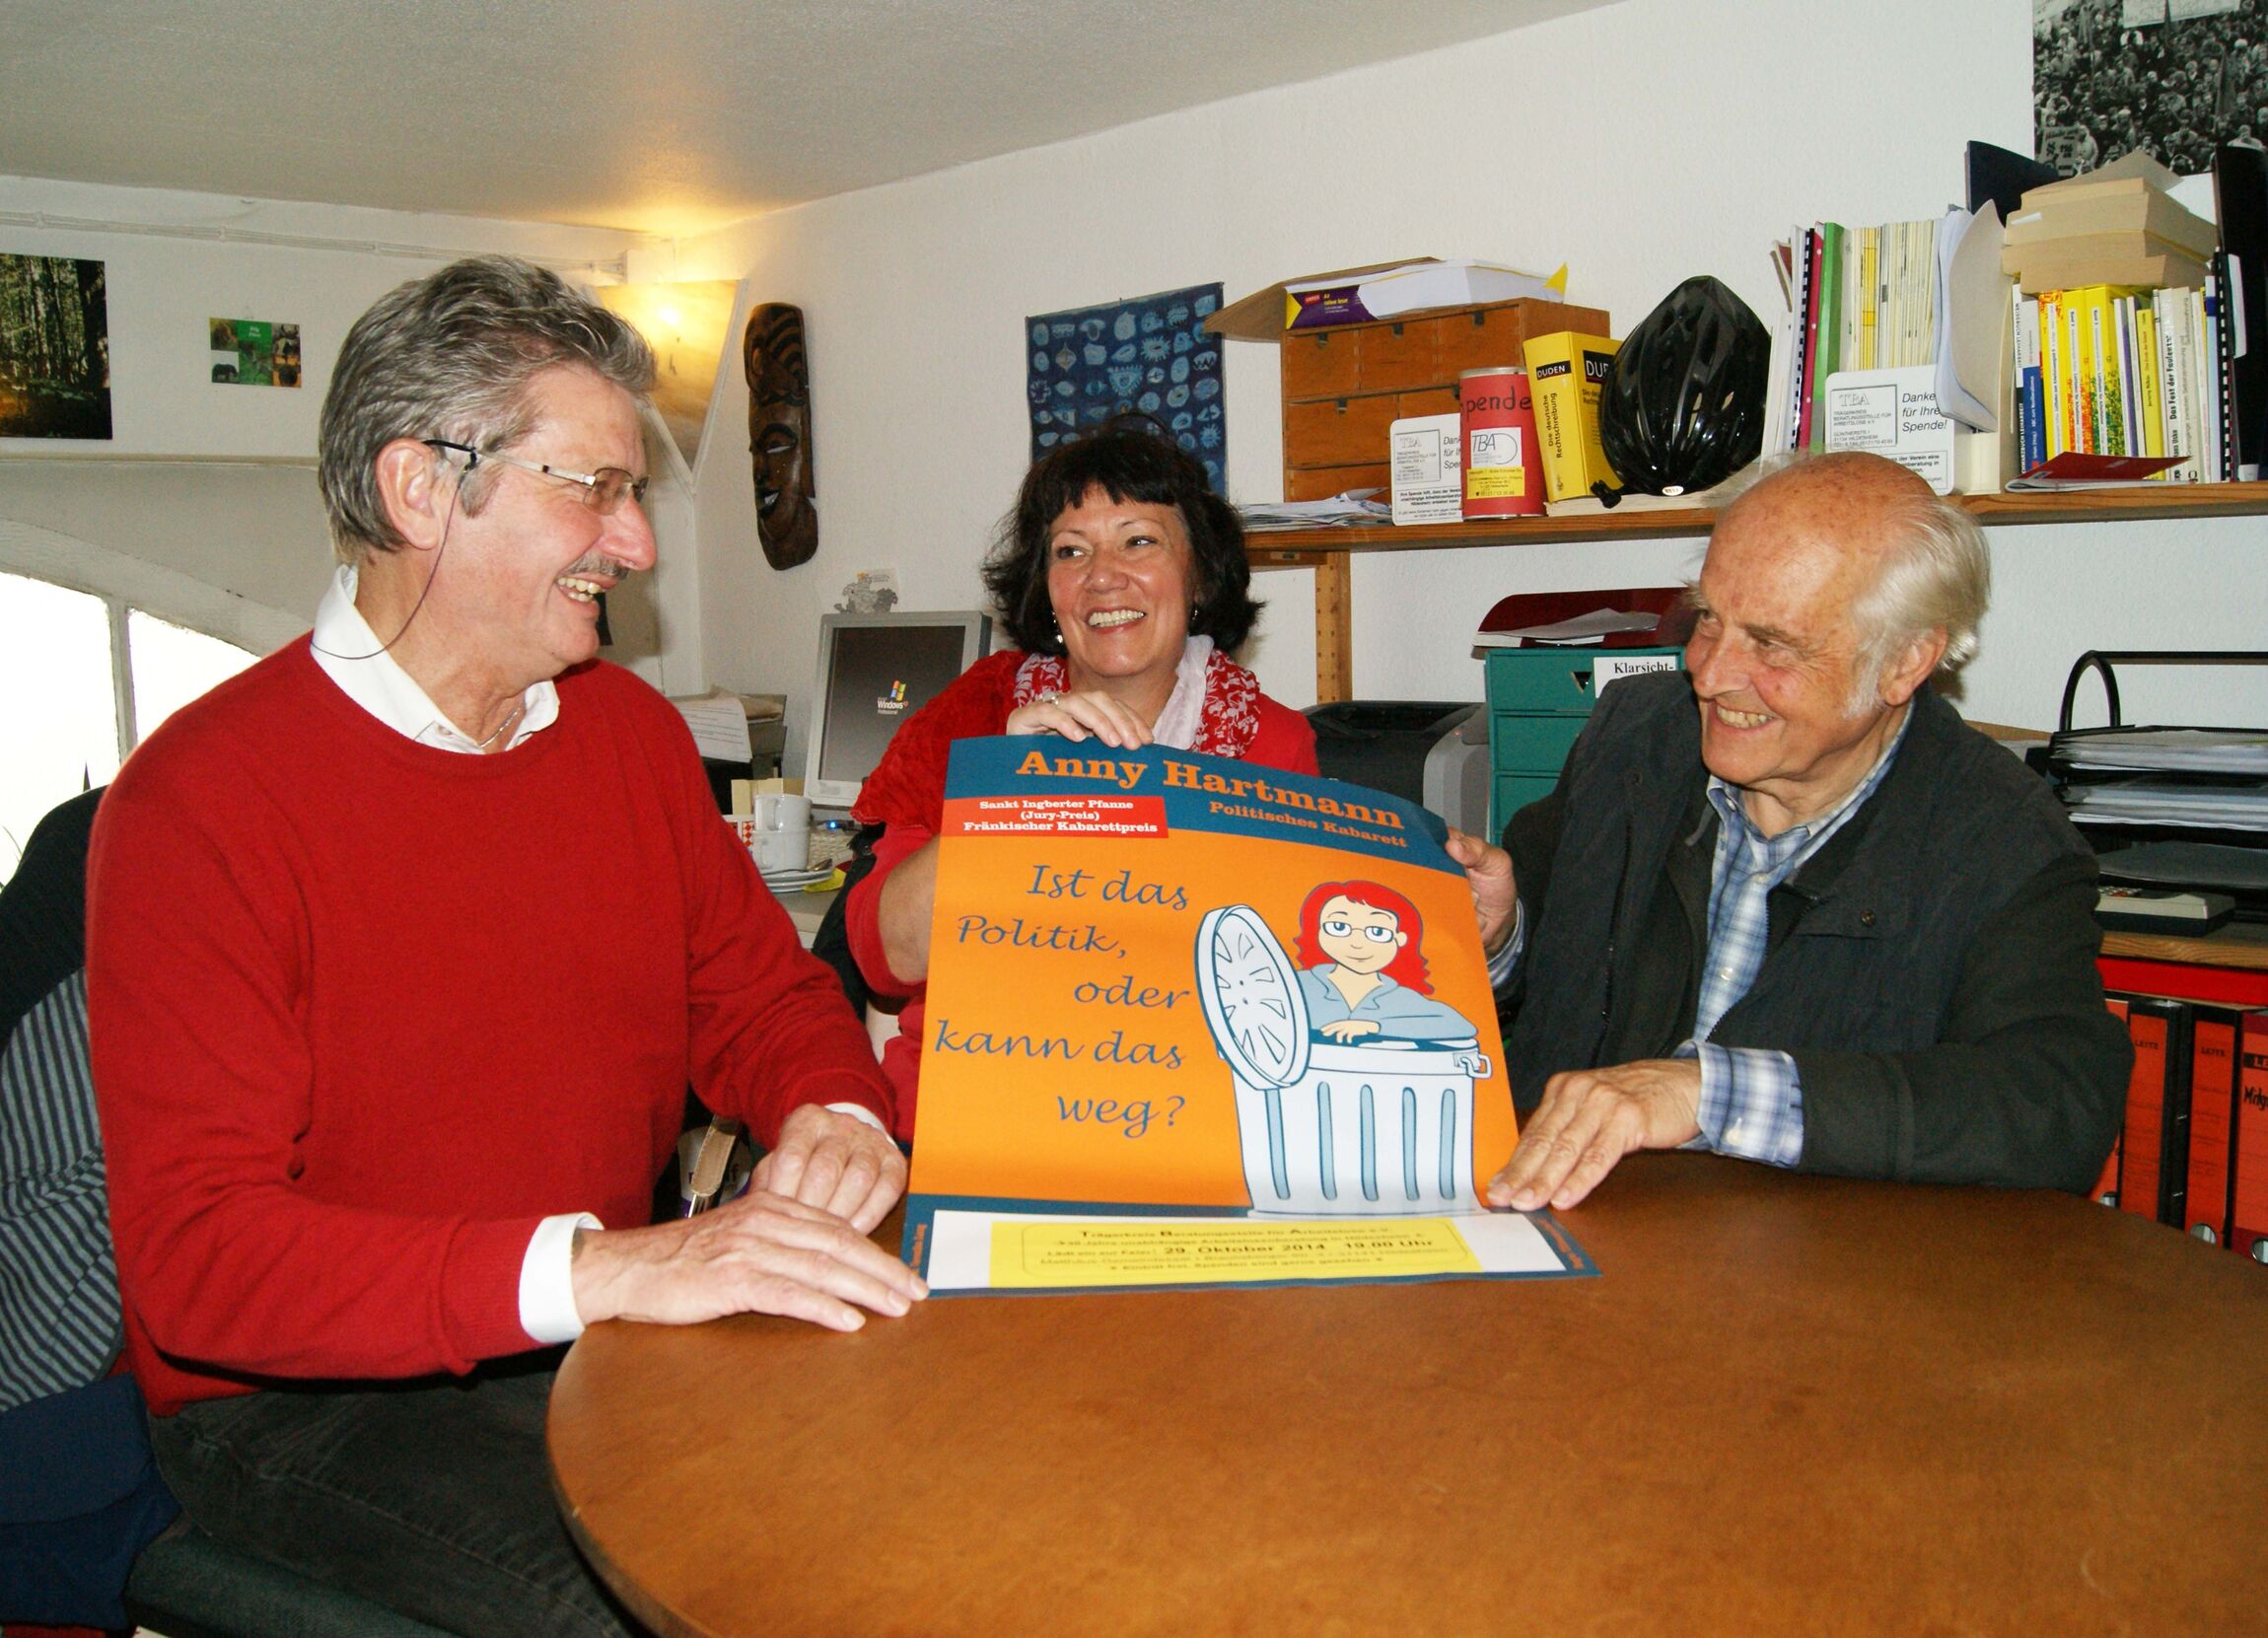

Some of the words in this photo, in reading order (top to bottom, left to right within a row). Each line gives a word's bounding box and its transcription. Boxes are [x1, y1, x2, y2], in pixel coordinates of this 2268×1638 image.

[1536, 364, 1566, 379] DUDEN
[2166, 373, 2175, 387] der
[1460, 386, 1531, 422] pende
[1902, 392, 1937, 403] Danke
[1541, 393, 1553, 430] deutsche
[1902, 407, 1919, 417] für
[1920, 406, 1941, 415] Ihre
[1550, 392, 1563, 459] Rechtschreibung
[1902, 419, 1948, 434] Spende!
[1471, 432, 1496, 453] TBA
[1443, 448, 1453, 458] für
[1613, 662, 1674, 675] Klarsicht-
[877, 699, 904, 710] Windows
[1016, 750, 1148, 790] Anny
[1163, 759, 1405, 830] Hartmann
[979, 801, 1019, 810] Sankt
[1023, 800, 1086, 811] Ingberter
[1088, 800, 1134, 810] Pfanne
[1021, 811, 1100, 821] (Jury-Preis)
[963, 821, 1054, 832] Fränkischer
[1057, 821, 1159, 834] Kabarettpreis
[1209, 801, 1318, 830] Politisches
[1322, 820, 1408, 848] Kabarett
[1026, 865, 1096, 898] Ist
[1101, 870, 1189, 911] das
[957, 915, 1127, 960] Politik,
[1074, 975, 1191, 1009] oder
[935, 1019, 1086, 1060] kann
[1093, 1031, 1187, 1070] das
[2253, 1056, 2268, 1068] LE
[1057, 1095, 1186, 1139] weg?
[1197, 1245, 1276, 1255] Oktober
[1282, 1243, 1326, 1252] 2014
[1343, 1240, 1394, 1249] 19.00
[1398, 1238, 1434, 1247] Uhr
